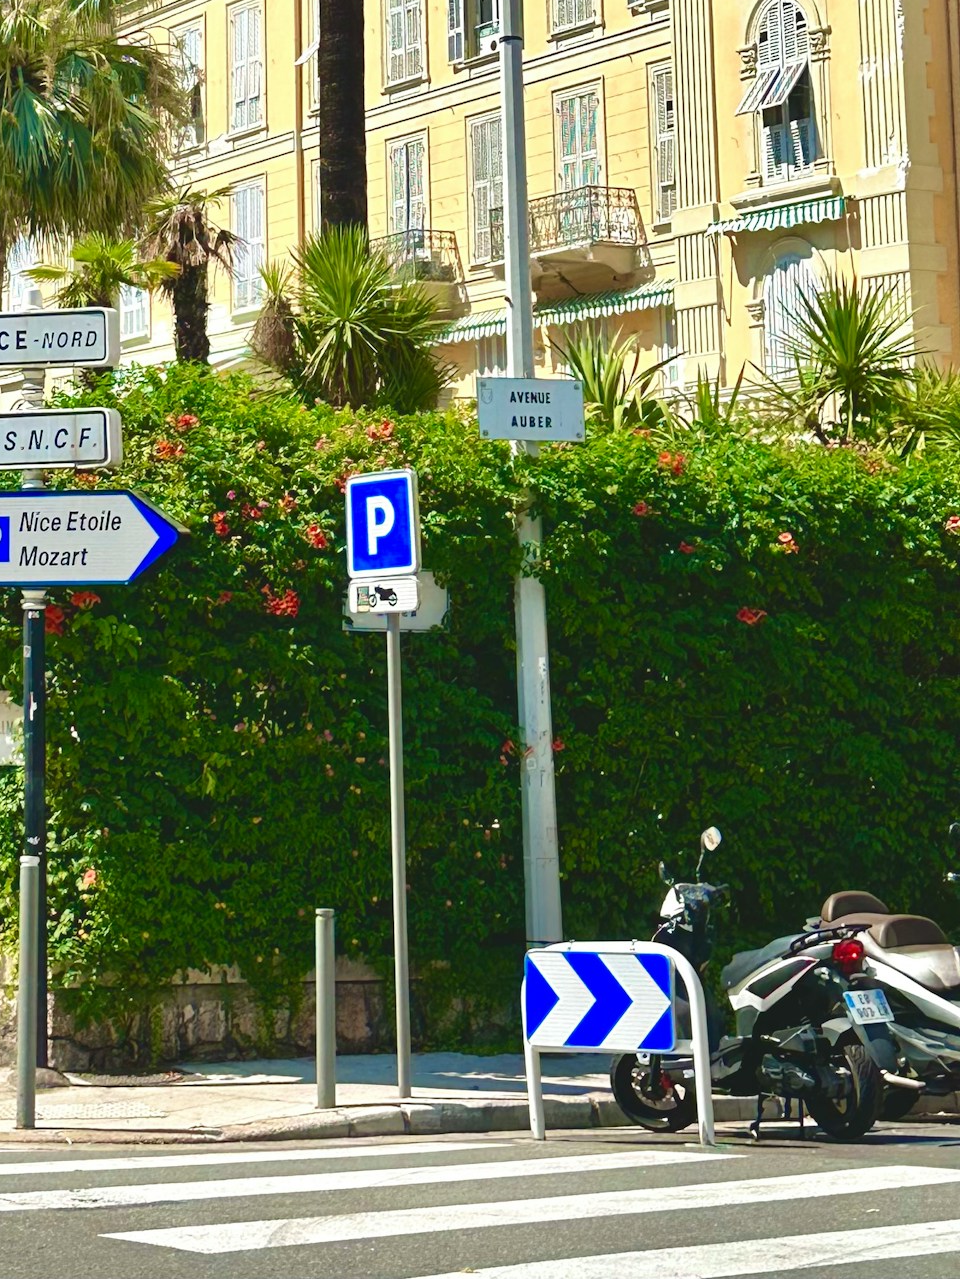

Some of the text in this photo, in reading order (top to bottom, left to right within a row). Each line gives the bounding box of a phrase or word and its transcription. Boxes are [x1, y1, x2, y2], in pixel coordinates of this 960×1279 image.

[510, 391, 551, 404] AVENUE
[511, 415, 552, 428] AUBER
[19, 510, 122, 532] Nice Etoile
[365, 494, 395, 556] P
[19, 545, 88, 567] Mozart
